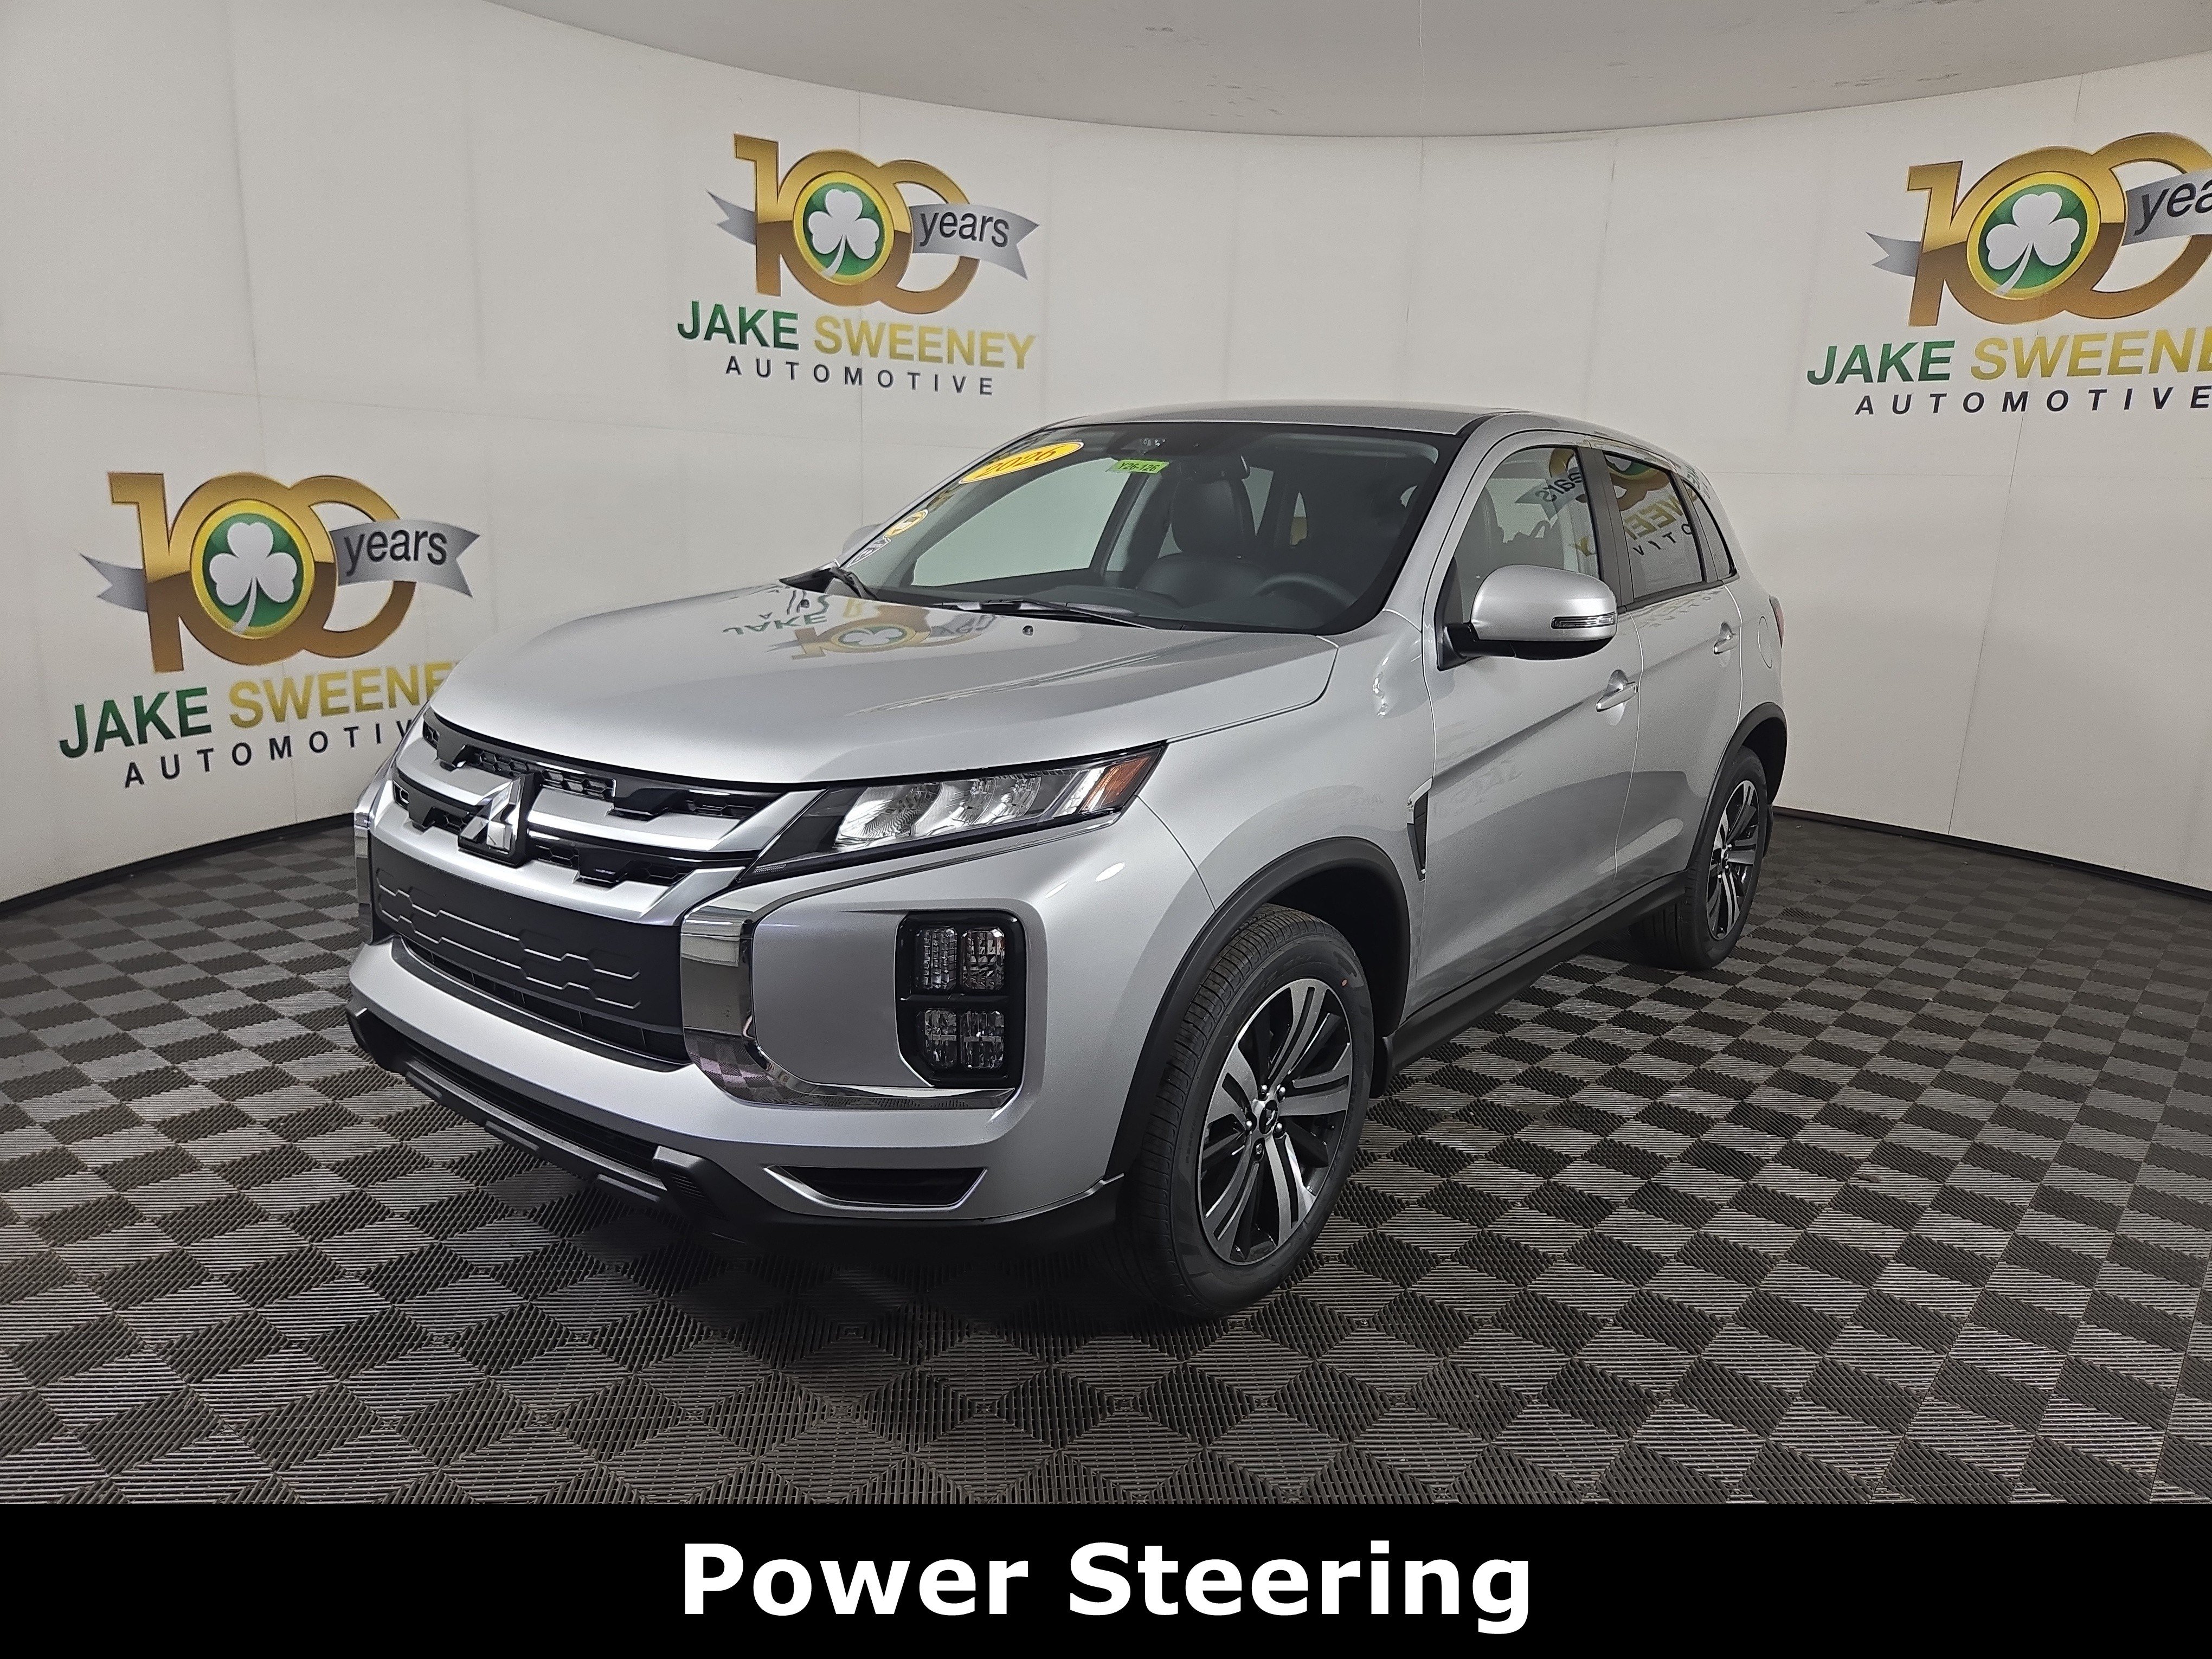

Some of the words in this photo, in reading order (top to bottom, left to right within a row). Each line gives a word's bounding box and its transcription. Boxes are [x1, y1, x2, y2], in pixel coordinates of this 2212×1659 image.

[734, 133, 980, 314] 100
[919, 211, 1009, 248] years
[2134, 179, 2212, 236] yea
[677, 301, 800, 350] JAKE
[814, 315, 1036, 370] SWEENEY
[1807, 340, 1955, 385] JAKE
[1971, 326, 2212, 381] SWEEN
[725, 356, 993, 395] AUTOMOTIVE
[1855, 385, 2212, 415] AUTOMOTIVE
[974, 445, 1066, 479] 2026
[107, 472, 417, 673] 100
[343, 528, 448, 576] years
[59, 687, 212, 758] JAKE
[229, 661, 453, 729] SWEENE
[125, 719, 413, 788] AUTOMOTIV
